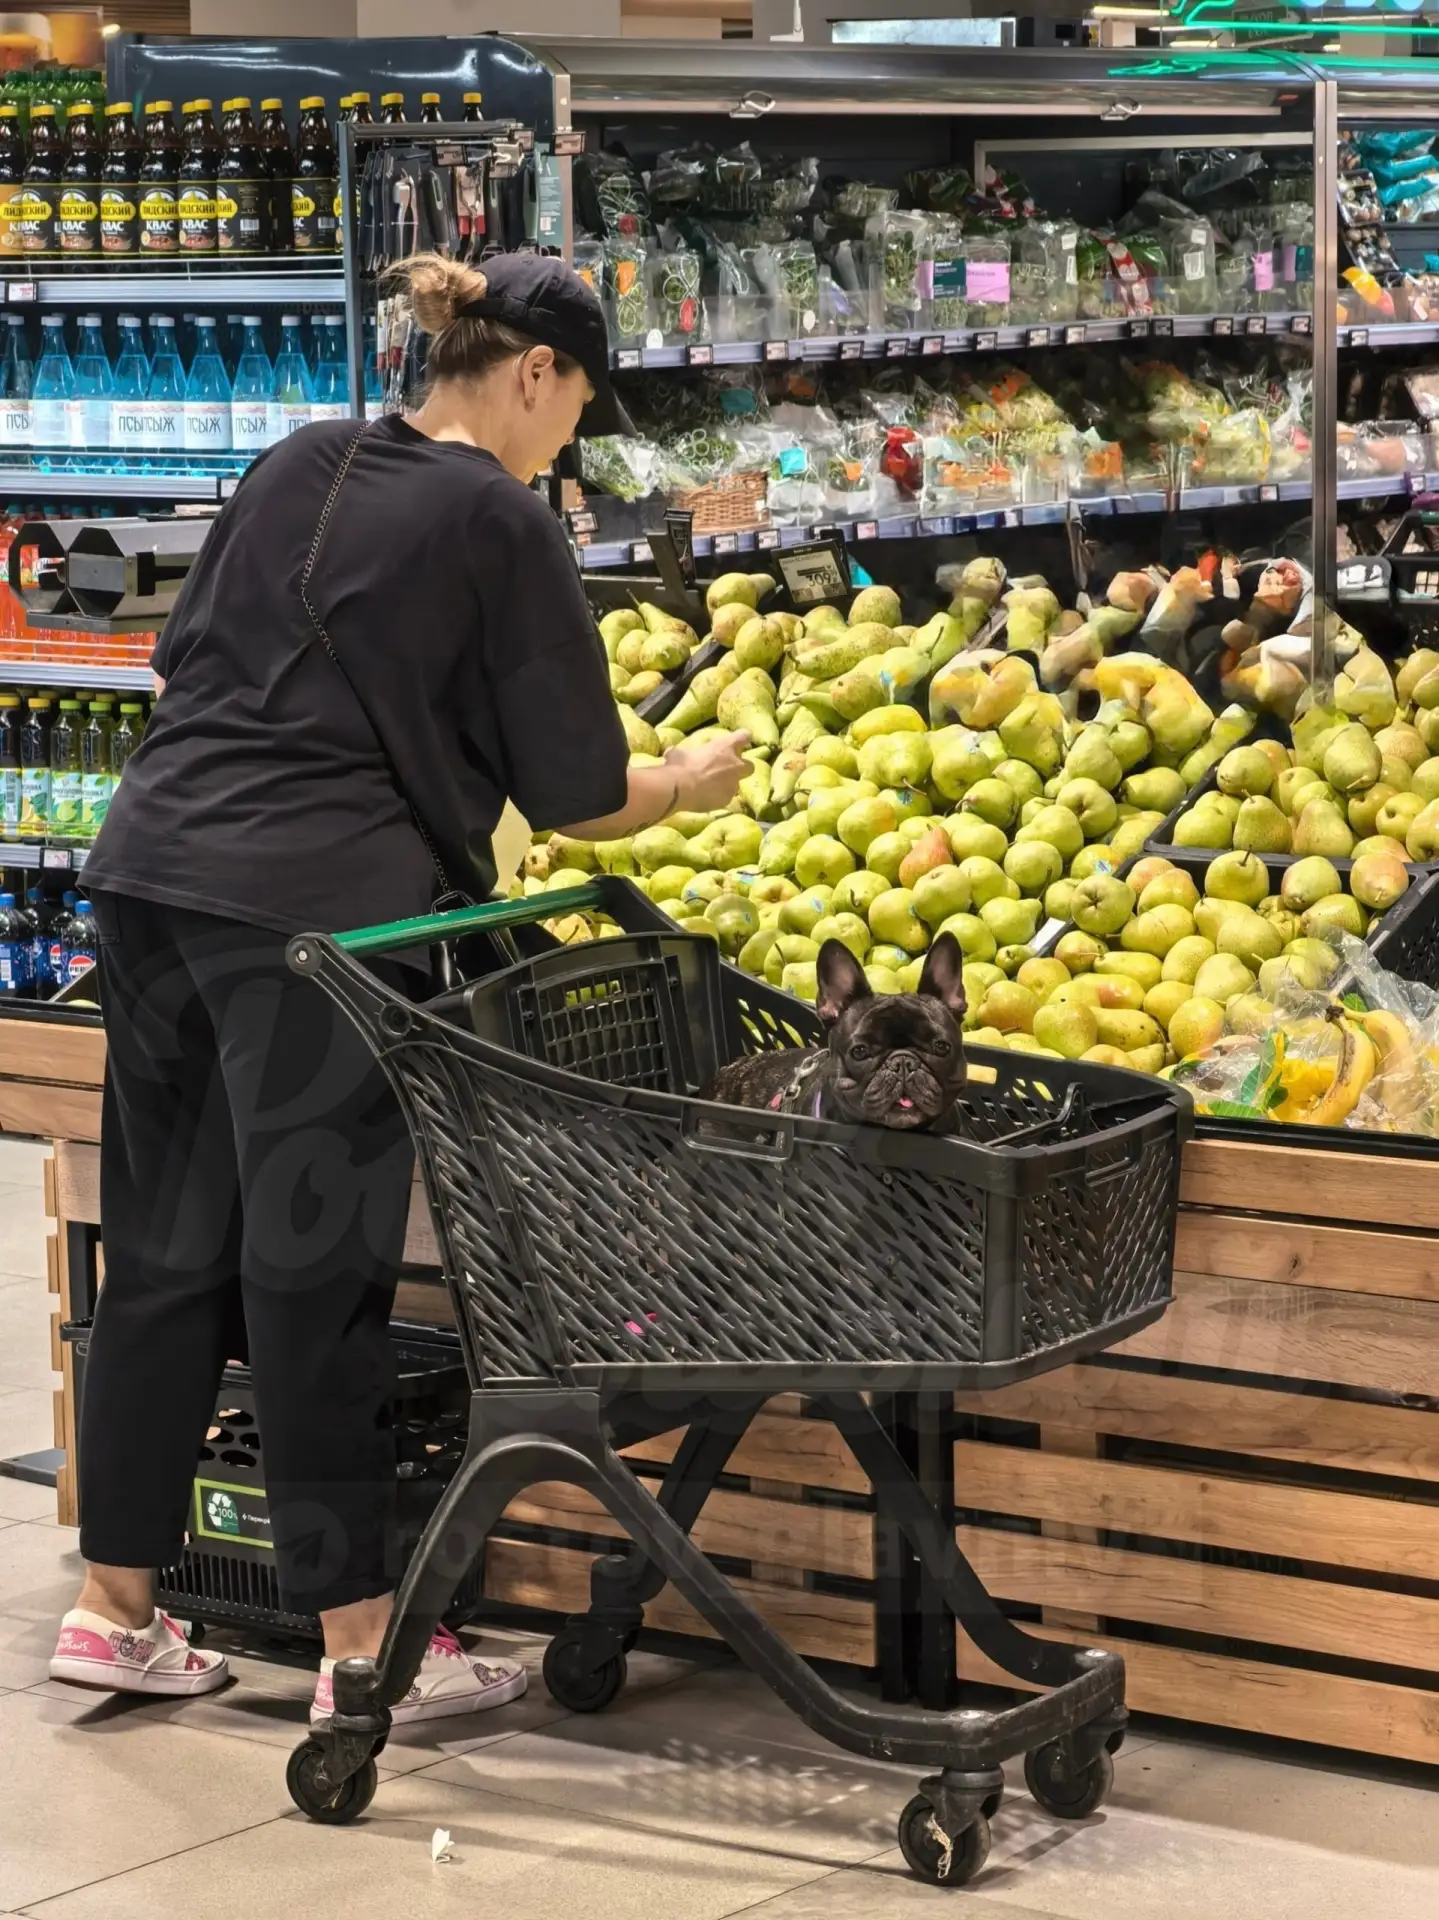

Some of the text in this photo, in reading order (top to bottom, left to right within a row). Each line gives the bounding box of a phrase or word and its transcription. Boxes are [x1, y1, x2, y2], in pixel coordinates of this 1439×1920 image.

[146, 220, 175, 231] КВАС
[182, 219, 209, 230] КВАС
[187, 416, 222, 434] ПСЫЖ
